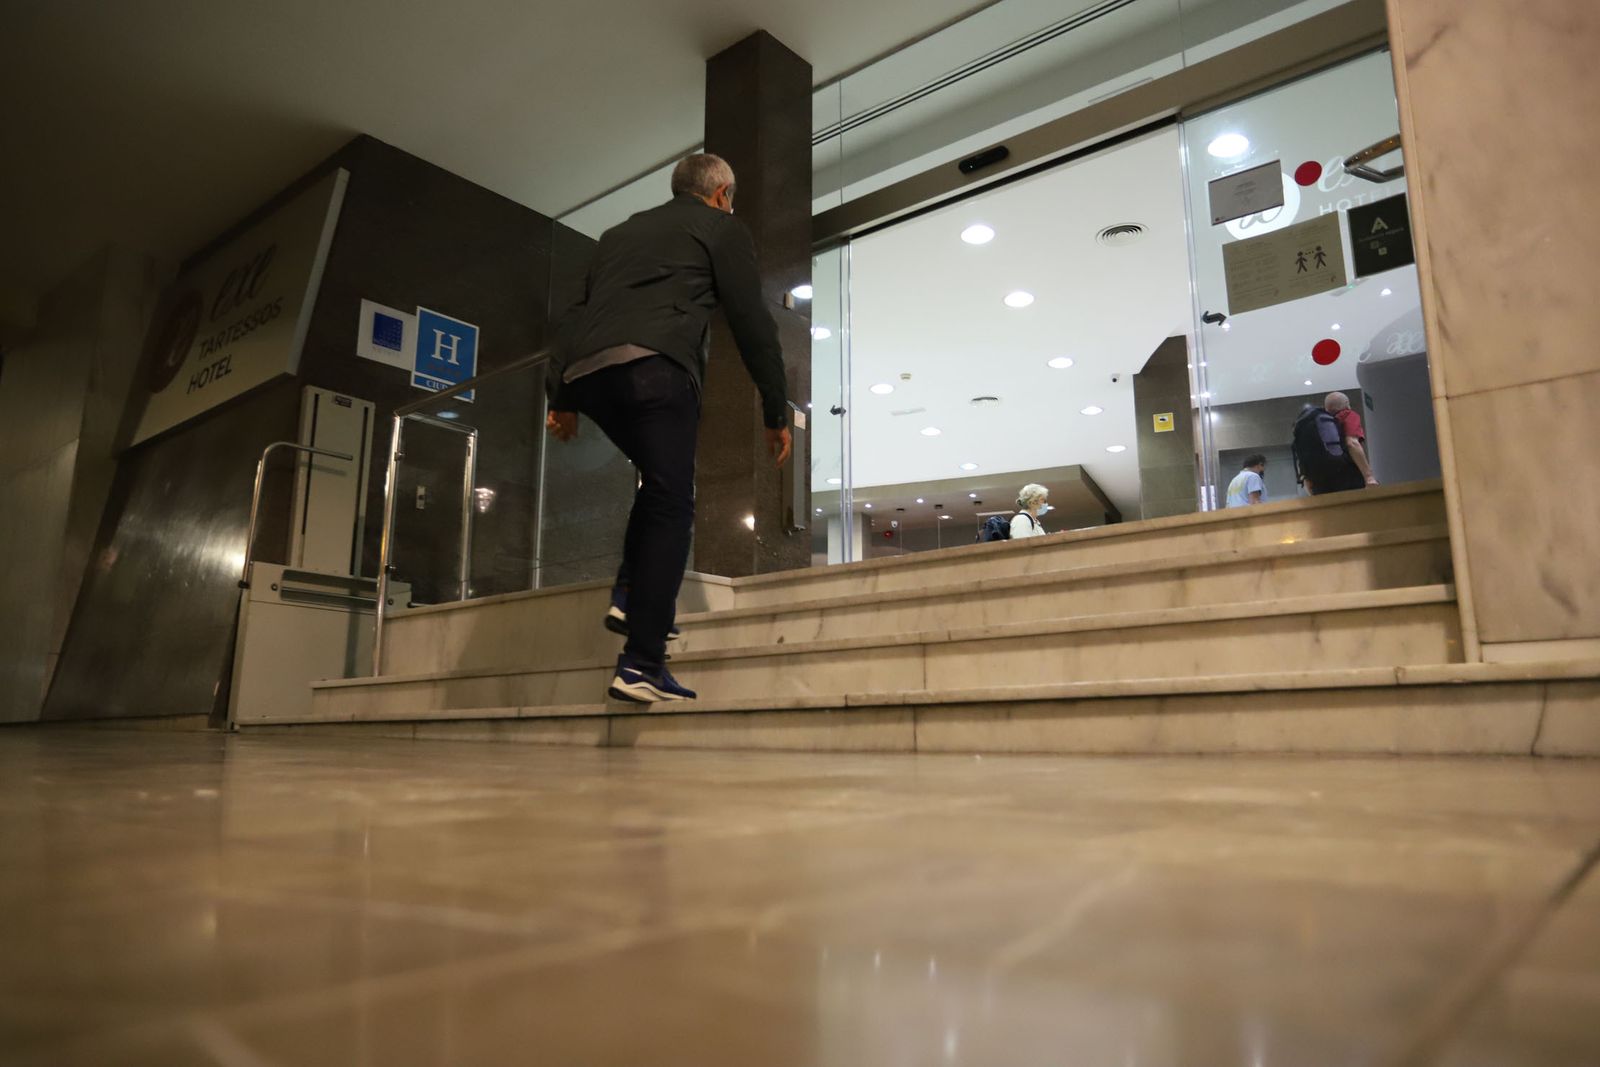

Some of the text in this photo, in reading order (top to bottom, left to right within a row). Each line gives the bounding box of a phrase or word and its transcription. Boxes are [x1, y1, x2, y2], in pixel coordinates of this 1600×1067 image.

[198, 297, 284, 361] TARTESSOS
[431, 328, 462, 366] H
[187, 354, 232, 395] HOTEL
